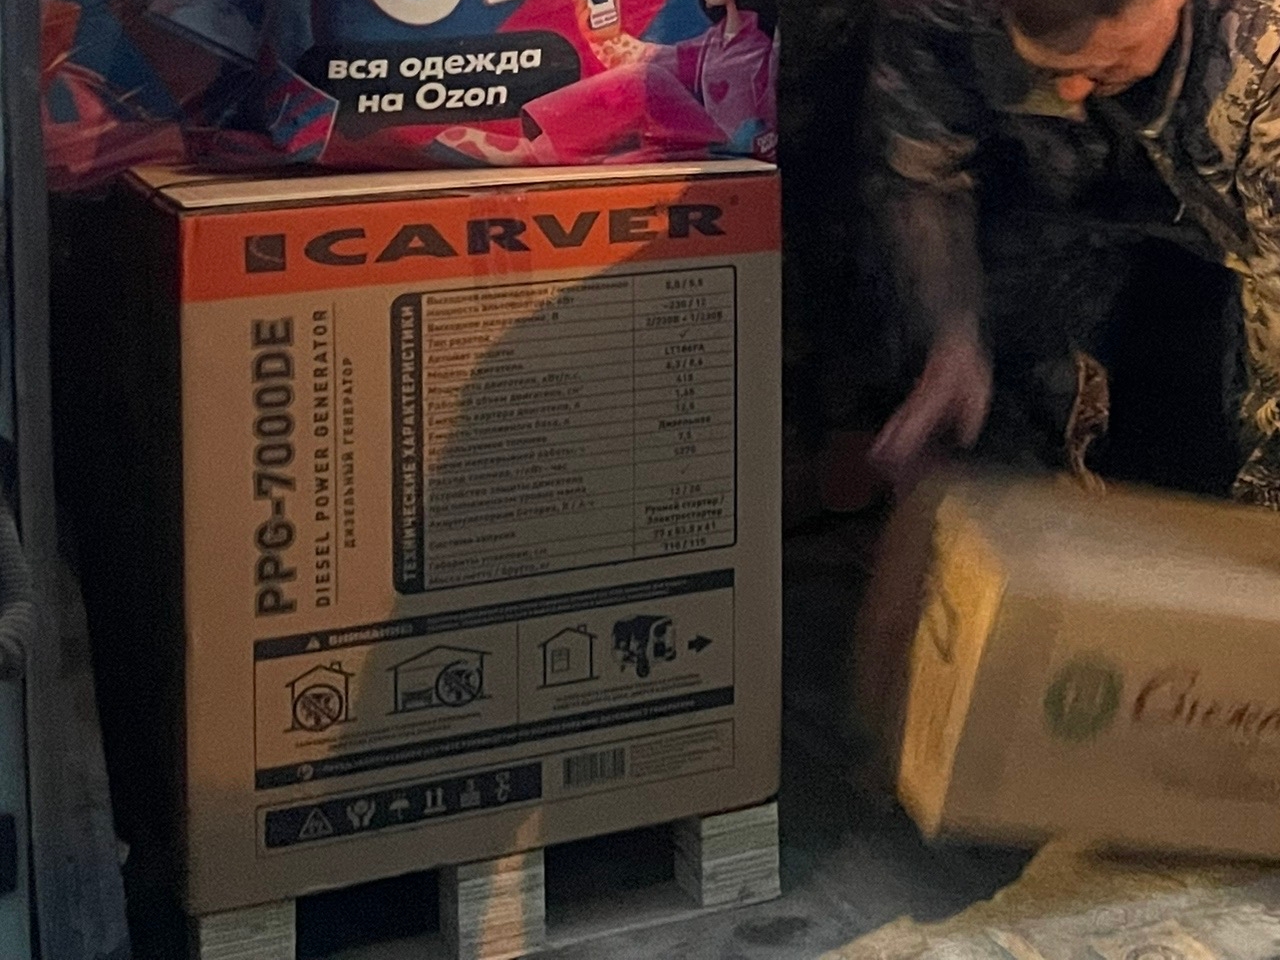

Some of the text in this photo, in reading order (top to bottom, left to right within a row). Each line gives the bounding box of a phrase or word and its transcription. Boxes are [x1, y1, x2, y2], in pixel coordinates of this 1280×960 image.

[328, 45, 542, 81] вся одежда
[357, 80, 508, 113] на Ozon
[304, 203, 726, 267] CARVER
[251, 315, 298, 619] PPG-7000DE
[312, 309, 332, 608] DIESEL POWER GENERATOR
[341, 357, 358, 549] ДИЗЕЛЬНЫЙ ГЕНЕРАТОР
[400, 464, 419, 581] ТЕХНИЧЕСКИЕ
